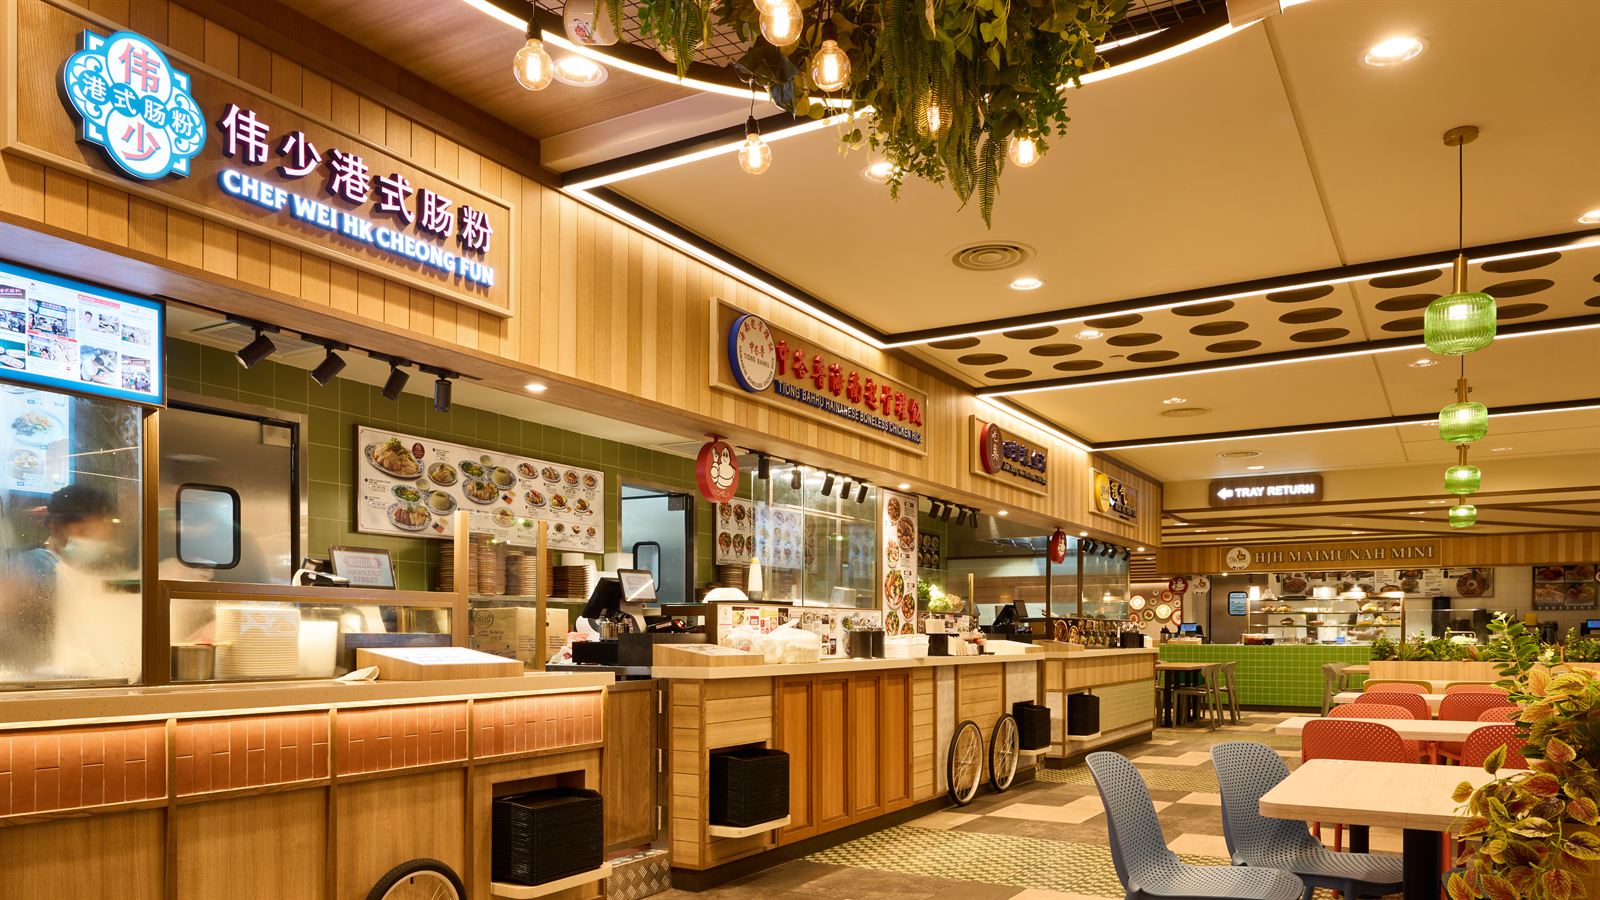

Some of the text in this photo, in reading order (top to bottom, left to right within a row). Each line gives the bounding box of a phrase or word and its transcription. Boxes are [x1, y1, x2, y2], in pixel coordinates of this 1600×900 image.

[118, 42, 161, 93] 伟
[82, 72, 194, 137] 港式肠粉
[121, 122, 162, 162] 少
[219, 103, 494, 253] 伟少港式肠粉
[222, 168, 495, 287] CHEF WEI HK CHEONG FUN
[779, 380, 800, 398] TIONG
[802, 388, 825, 407] BAHRU
[860, 411, 889, 431] BONELESS
[889, 421, 911, 440] CHICKEN
[1235, 484, 1315, 498] TRAY RETURN
[1255, 551, 1284, 565] HJH
[1289, 548, 1385, 563] MAIMUNAH
[1391, 546, 1434, 560] MINI
